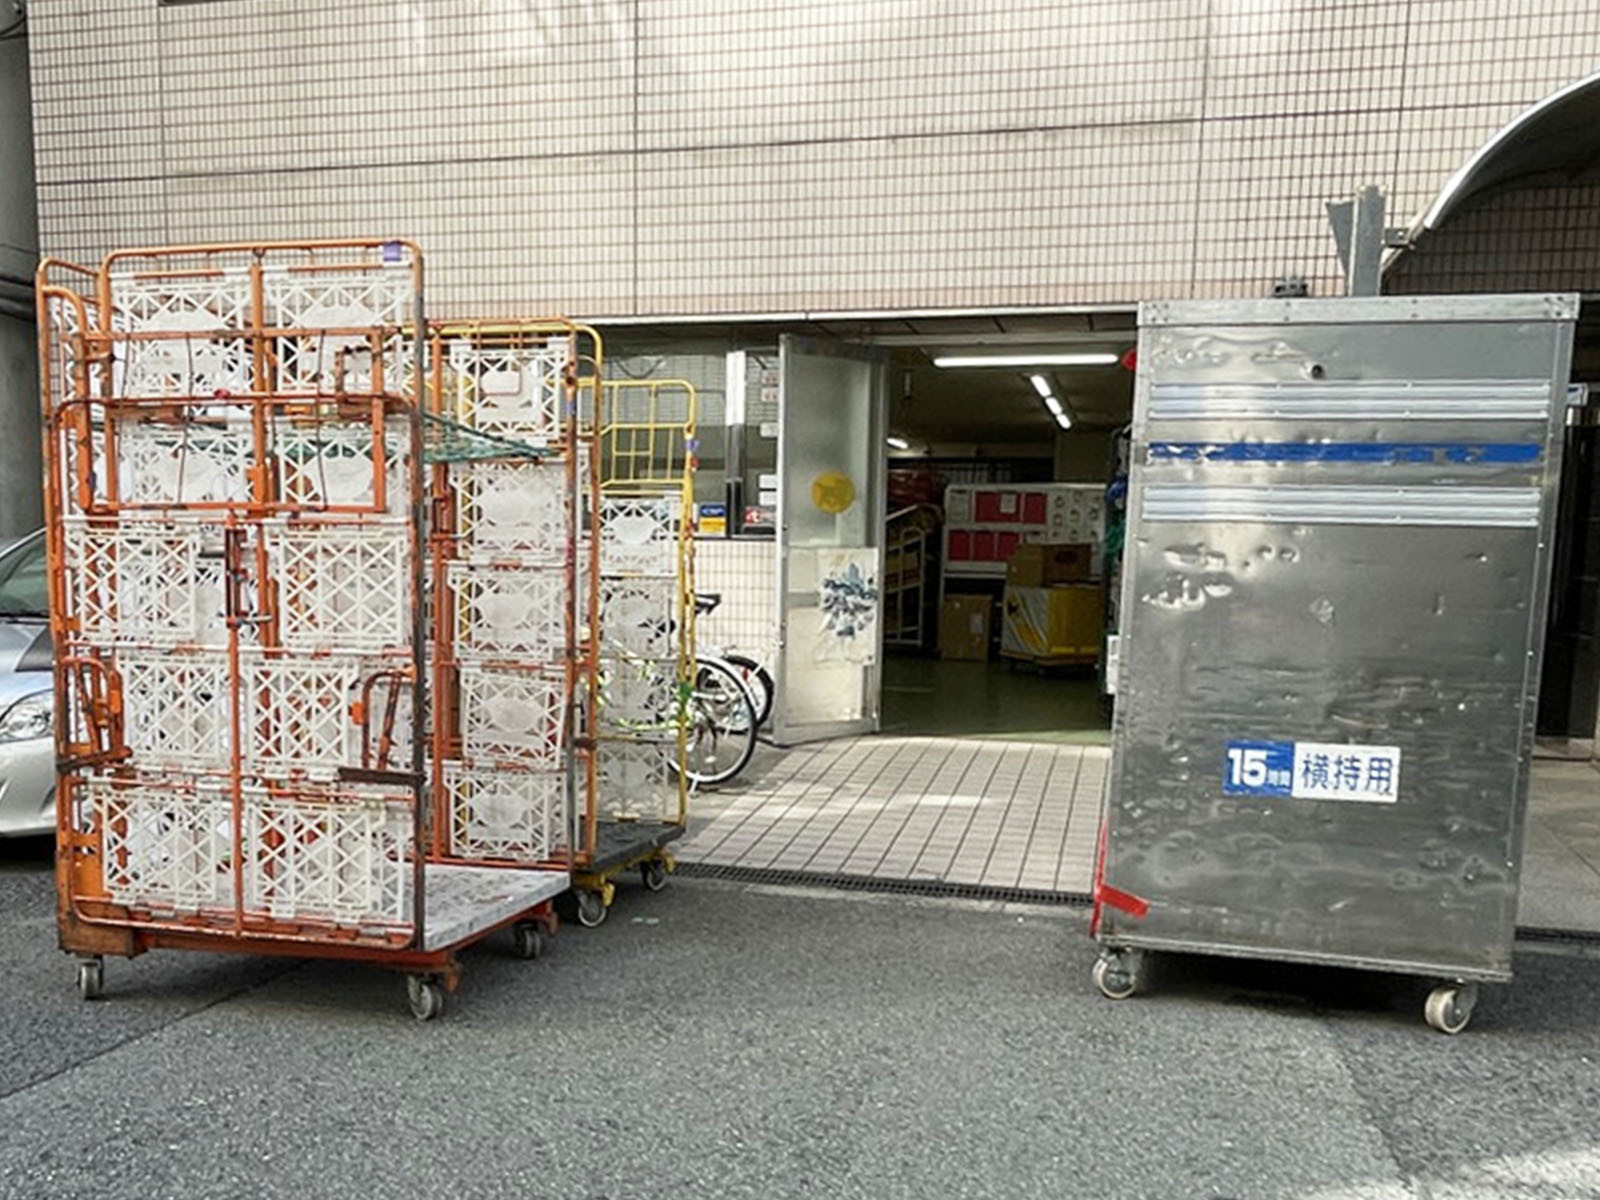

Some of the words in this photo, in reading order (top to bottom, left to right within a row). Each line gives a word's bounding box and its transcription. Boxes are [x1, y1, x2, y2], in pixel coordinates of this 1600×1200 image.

[1228, 748, 1267, 787] 15
[1302, 753, 1392, 794] 横持用
